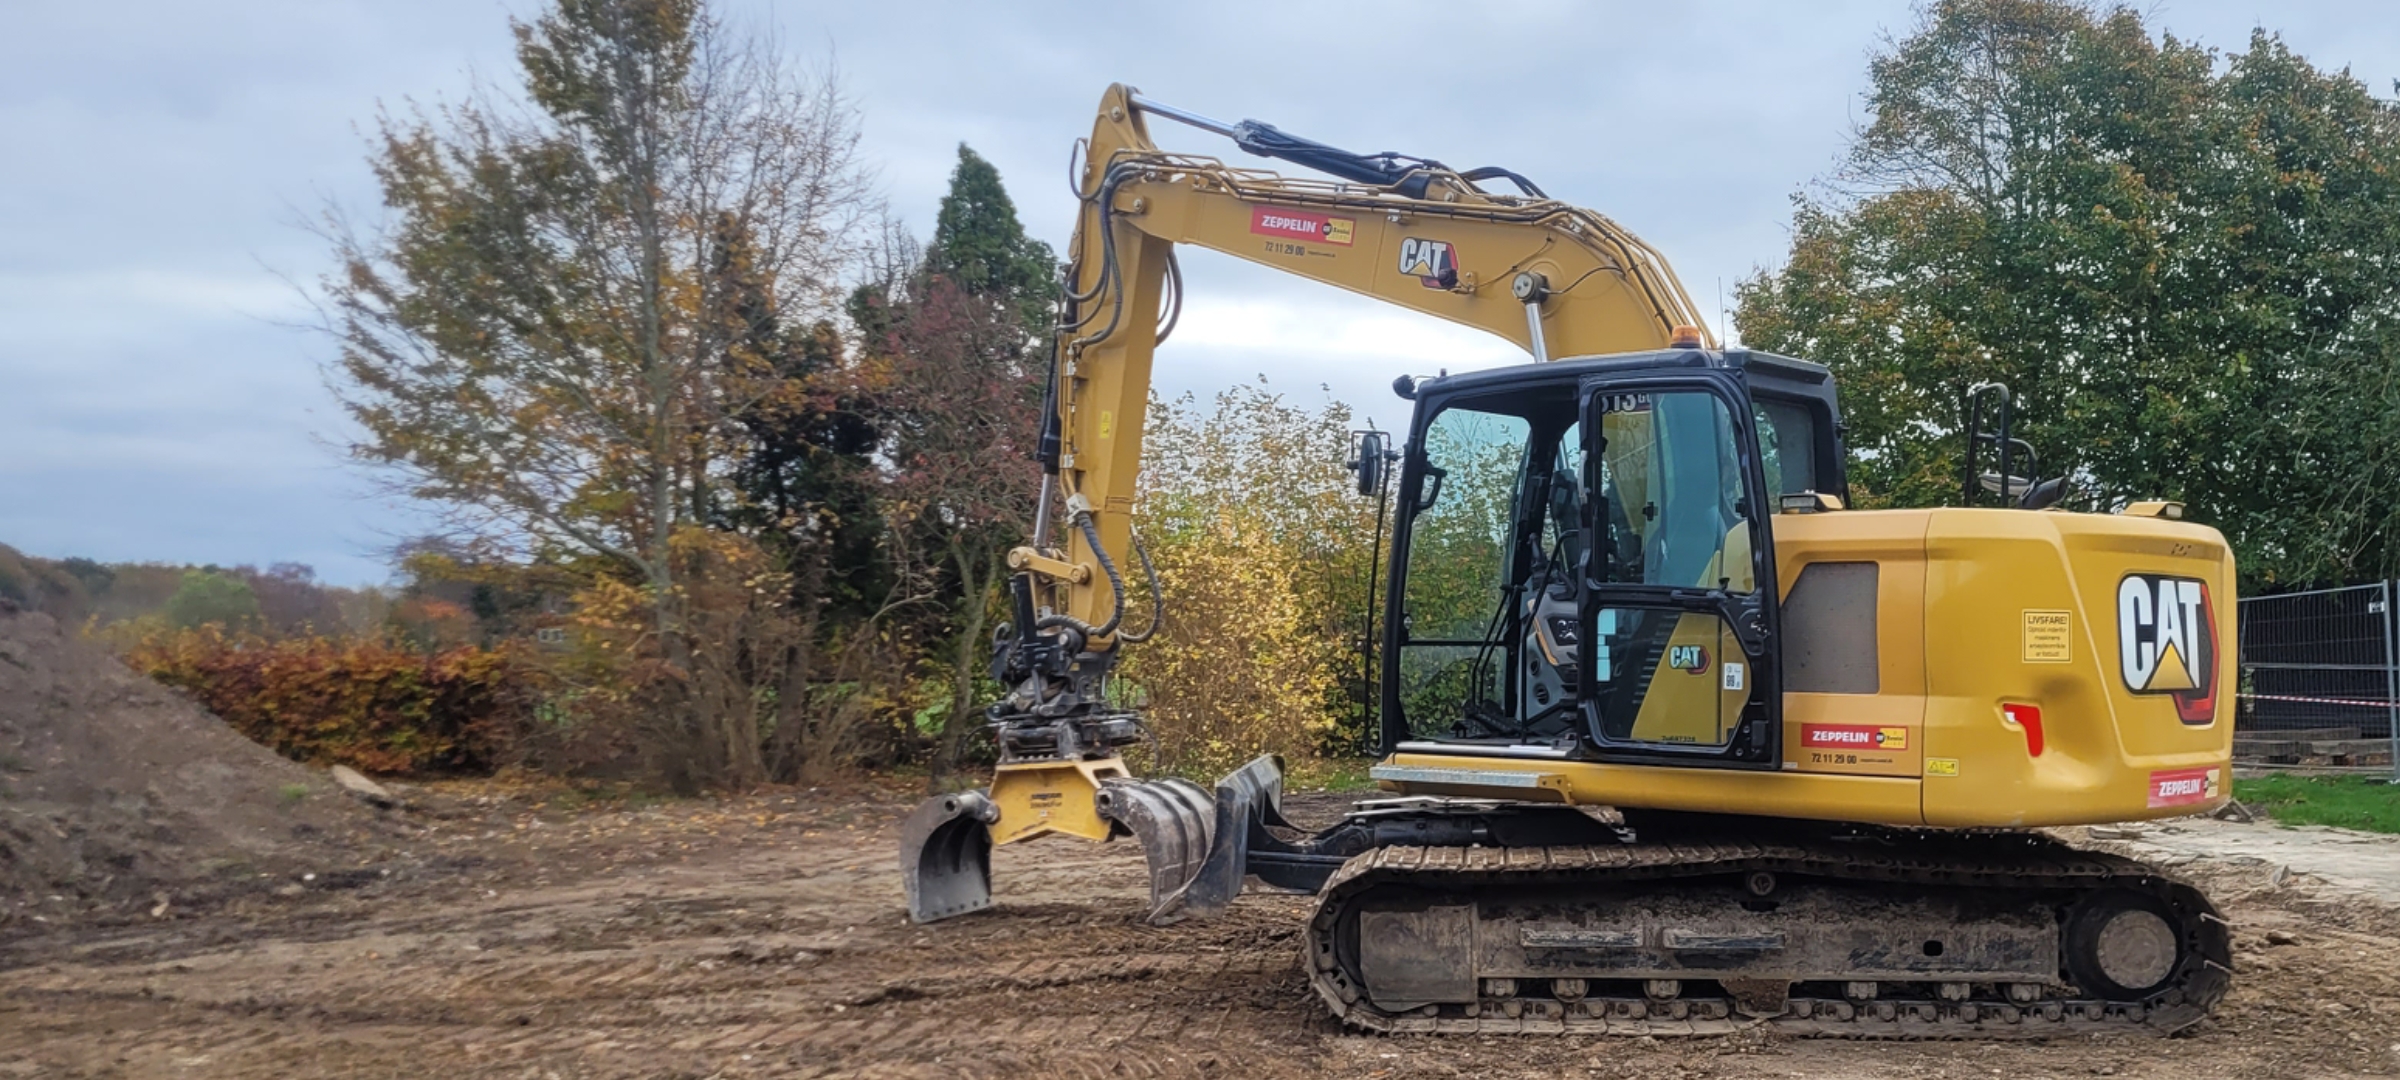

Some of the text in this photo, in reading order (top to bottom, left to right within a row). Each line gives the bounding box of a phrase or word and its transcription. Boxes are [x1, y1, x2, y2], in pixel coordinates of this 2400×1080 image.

[1261, 214, 1317, 233] ZEPPELIN
[1265, 241, 1273, 252] 72
[1275, 243, 1283, 253] 11
[1284, 244, 1294, 255] 29
[1295, 246, 1305, 256] 00
[1400, 238, 1447, 278] CAT
[2027, 615, 2068, 625] LIVSFARE!
[2119, 576, 2202, 691] CAT
[1670, 646, 1701, 669] CAT
[1812, 731, 1870, 743] ZEPPELIN
[1811, 753, 1821, 763] 72
[1823, 754, 1832, 763] 11
[1834, 754, 1845, 764] 29
[1846, 755, 1857, 764] 00
[2158, 778, 2201, 797] ZEPPELIN
